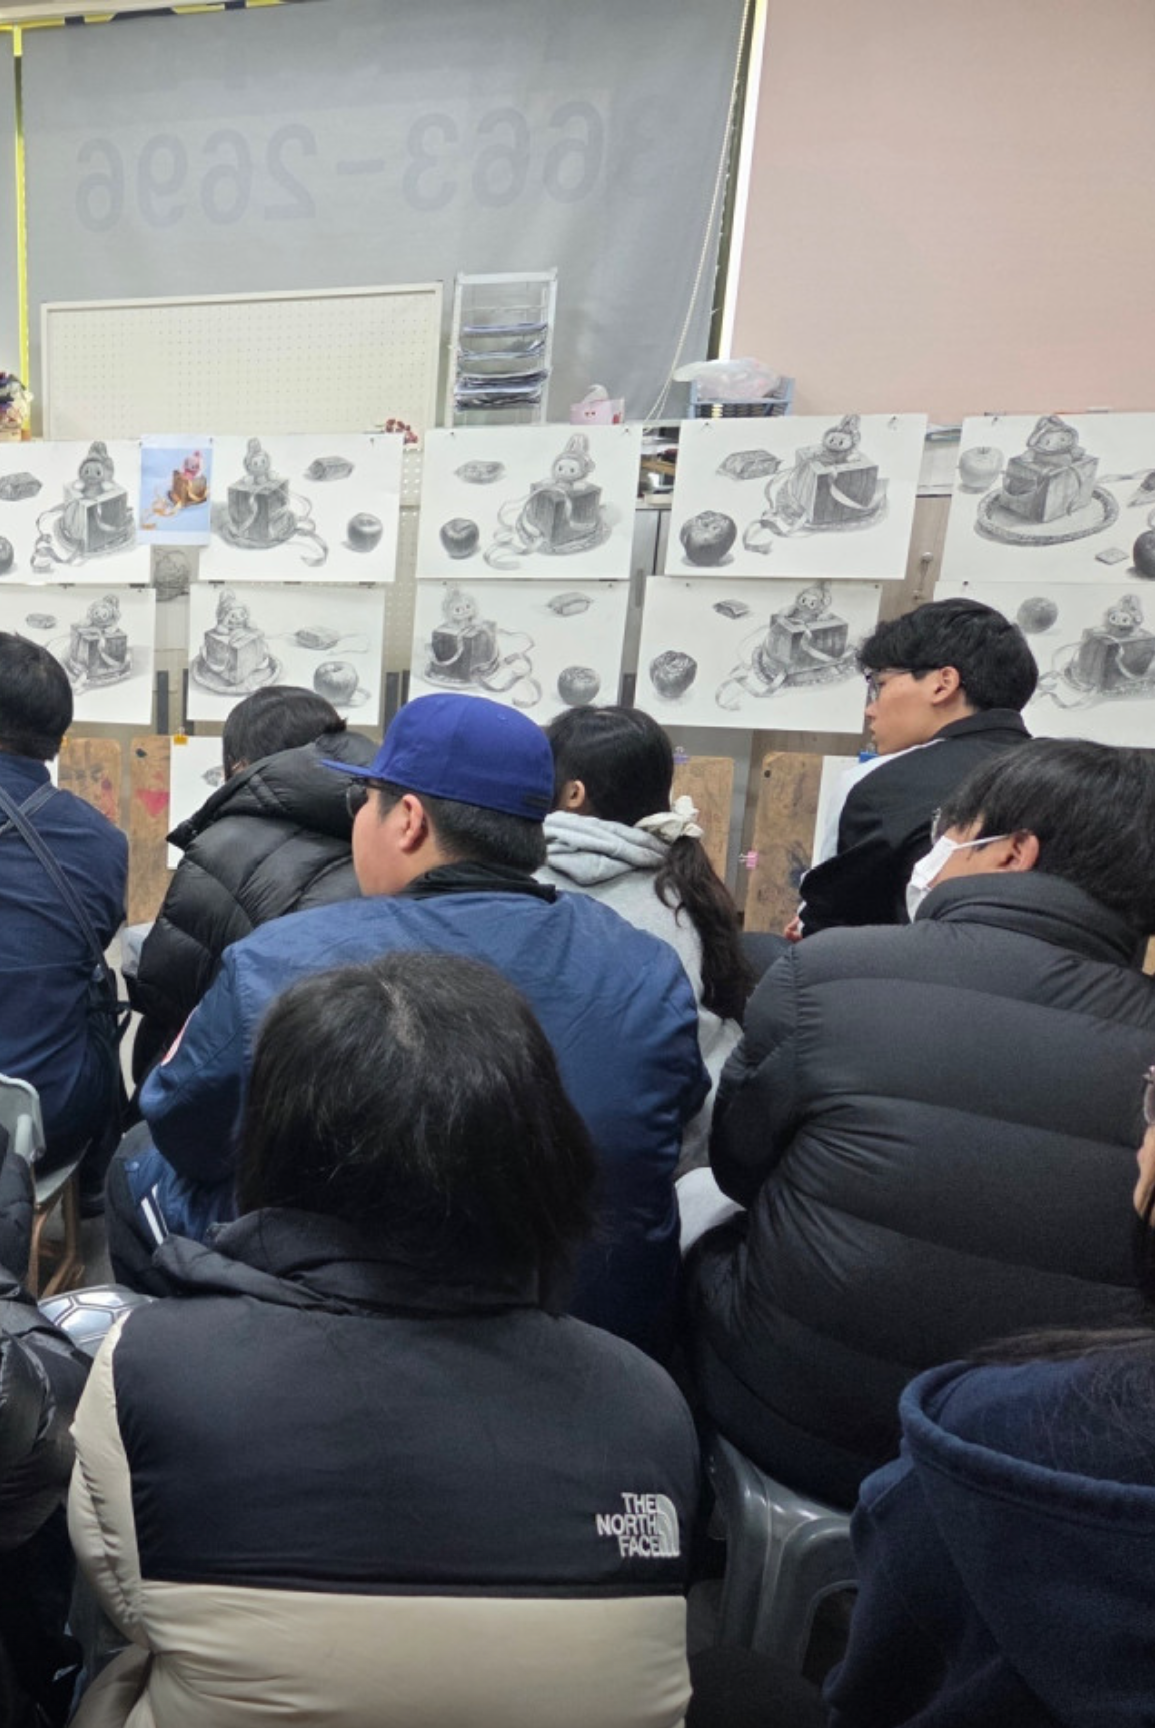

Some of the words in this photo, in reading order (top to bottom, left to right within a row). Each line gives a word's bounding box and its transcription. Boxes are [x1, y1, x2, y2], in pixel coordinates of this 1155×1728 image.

[620, 1492, 658, 1514] THE
[595, 1513, 657, 1536] NORTH
[618, 1535, 660, 1557] FACE
